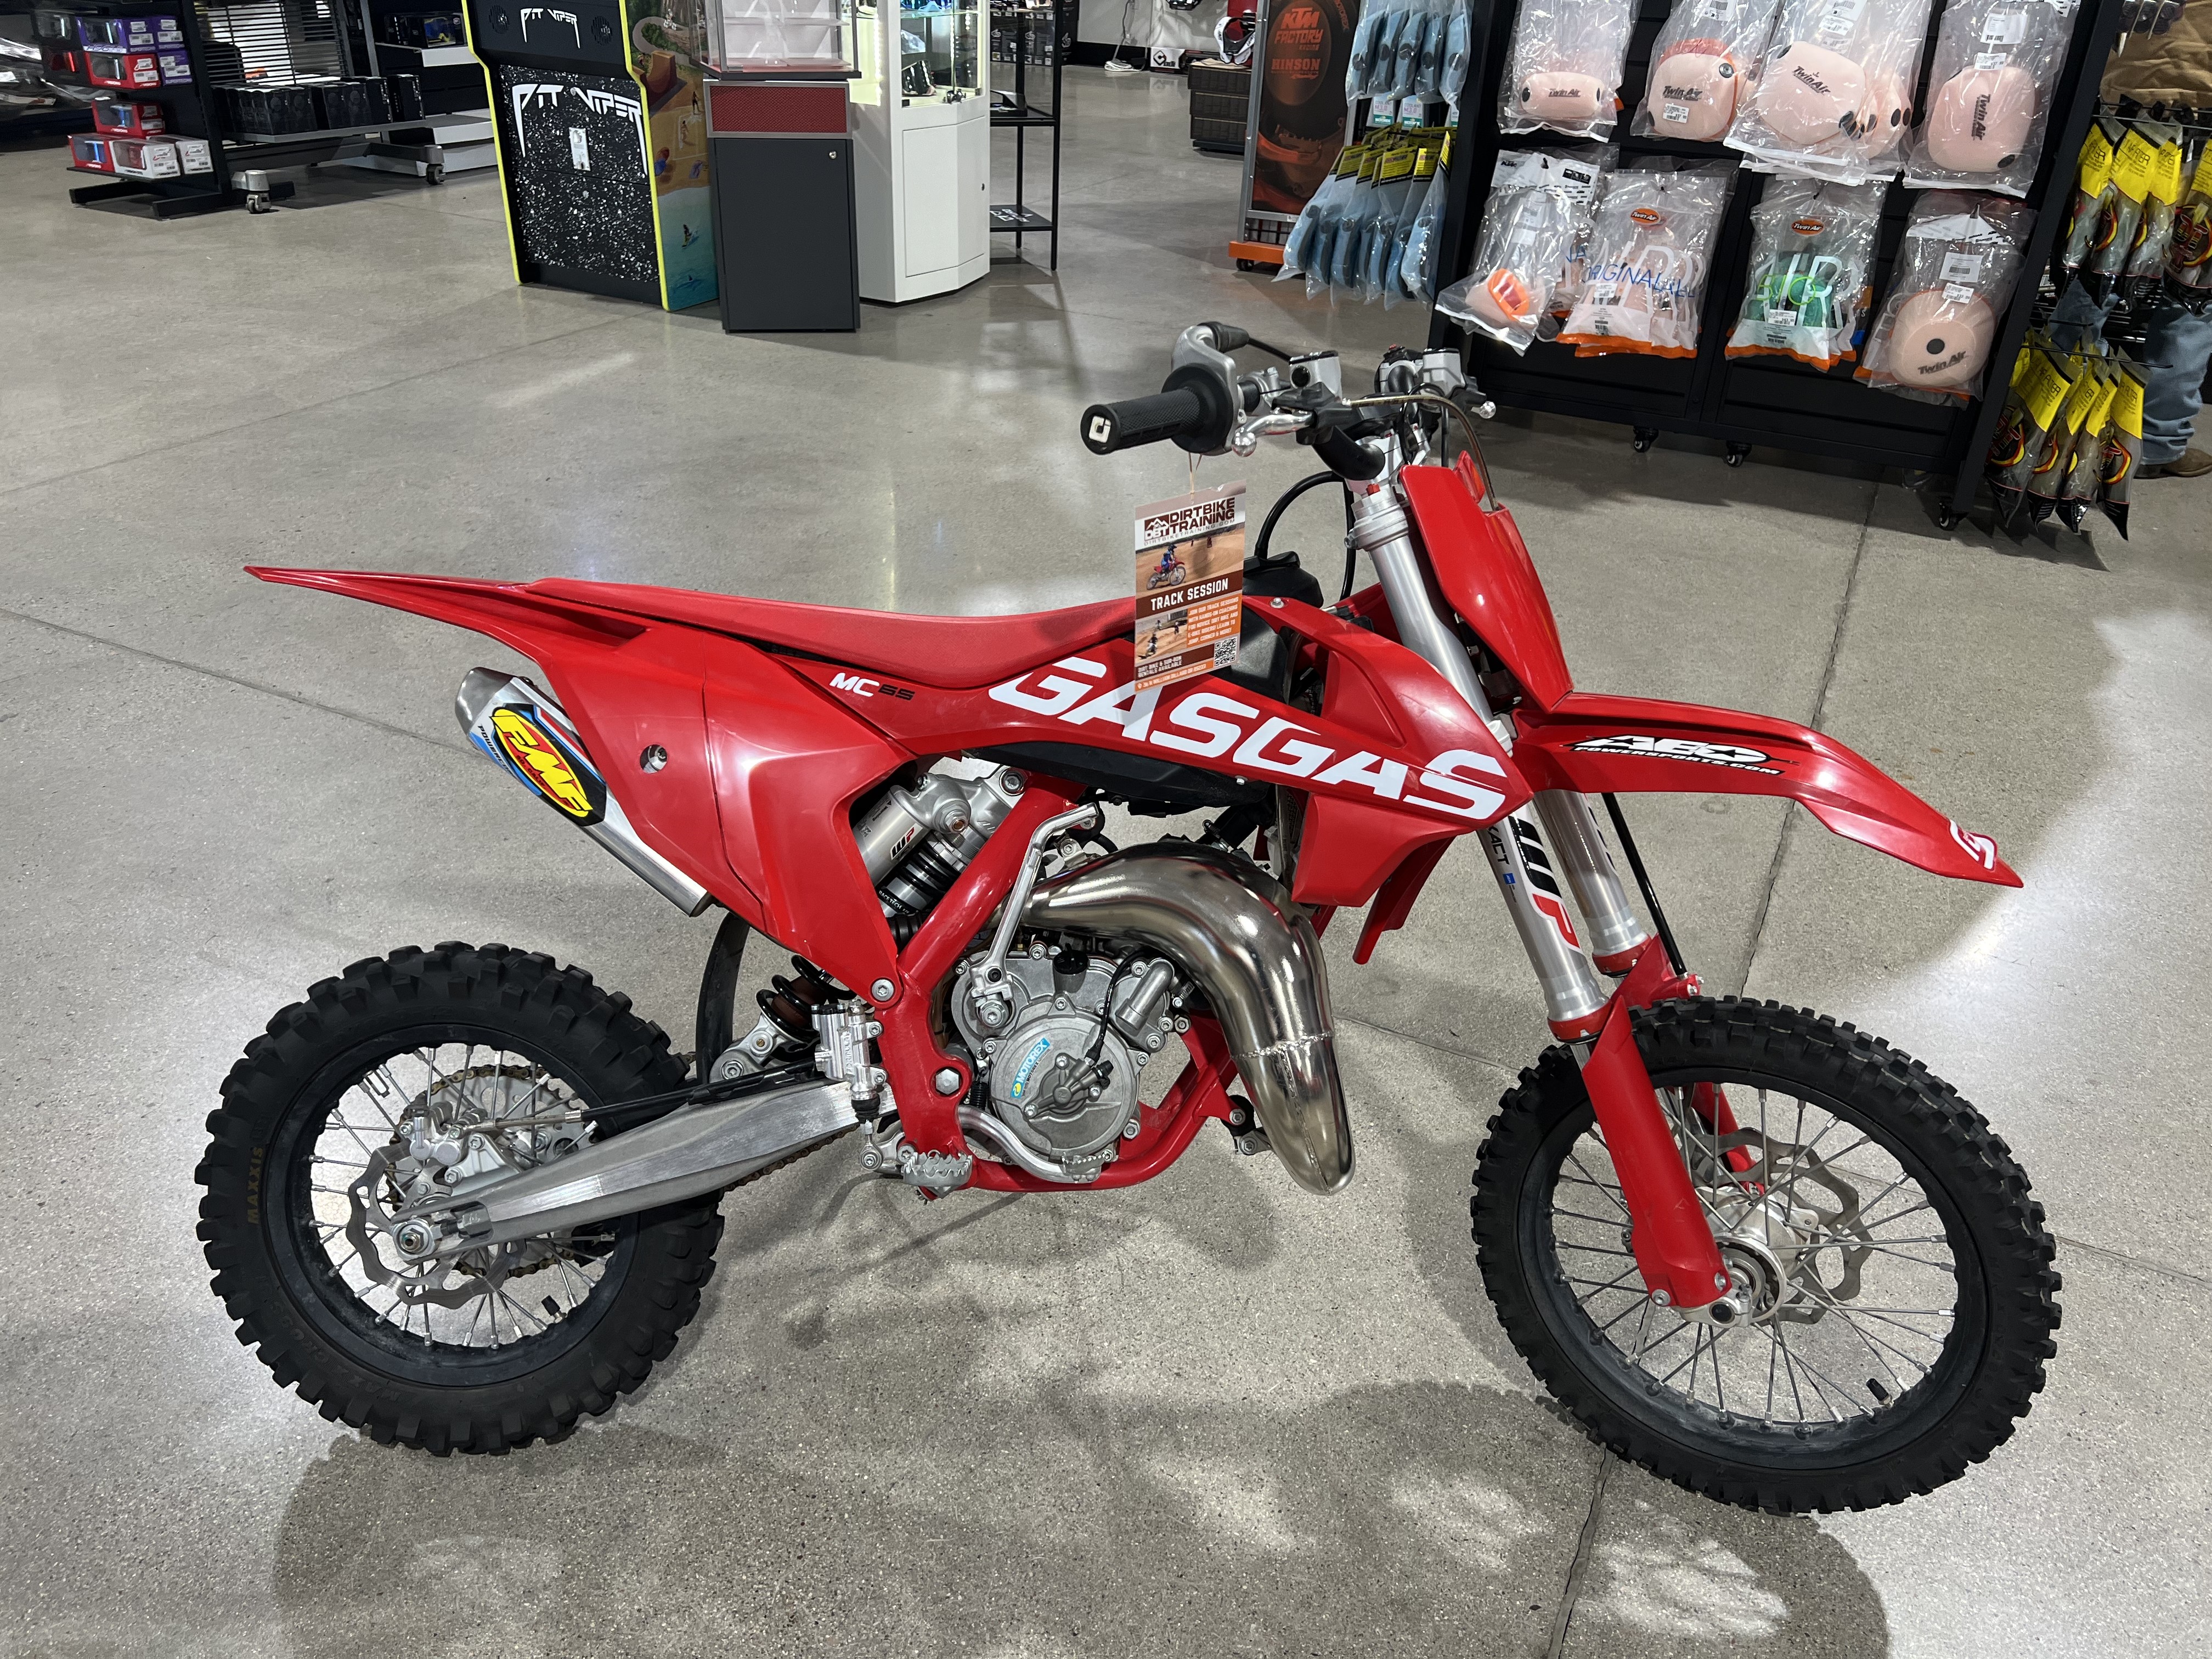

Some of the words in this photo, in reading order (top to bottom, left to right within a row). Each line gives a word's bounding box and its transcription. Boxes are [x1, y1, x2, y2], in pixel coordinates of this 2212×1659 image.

[520, 8, 544, 43] PIT
[547, 9, 580, 48] VIPER
[1280, 7, 1320, 29] KTM
[1274, 29, 1324, 44] FACTORY
[1271, 58, 1321, 70] HINSON
[1549, 88, 1567, 97] Twin
[1568, 88, 1581, 96] Air
[1663, 86, 1683, 96] Twin
[1793, 65, 1815, 83] Twin
[1812, 81, 1831, 94] Air
[1977, 94, 1990, 121] Twin
[512, 84, 564, 157] PIT
[571, 87, 648, 176] VIPER
[1975, 121, 1987, 140] Air
[1917, 361, 1947, 375] Twin
[1947, 351, 1966, 367] Air
[1170, 497, 1235, 523] DIRTBIKE
[1170, 509, 1234, 534] TRAINING
[1144, 519, 1235, 546] DIRTBIKETRAINING.COM
[1144, 527, 1169, 541] DBT
[1150, 590, 1183, 611] TRACK
[1187, 578, 1229, 601] SESSION
[829, 673, 880, 697] MC
[989, 656, 1507, 820] GASGAS
[490, 715, 594, 811] FMF
[1573, 747, 1781, 775] POWERSPORTS.COM
[879, 890, 890, 901] RACE
[890, 898, 902, 910] TECH
[1015, 1040, 1047, 1084] MOTOREX
[247, 1147, 264, 1225] MAXXIS
